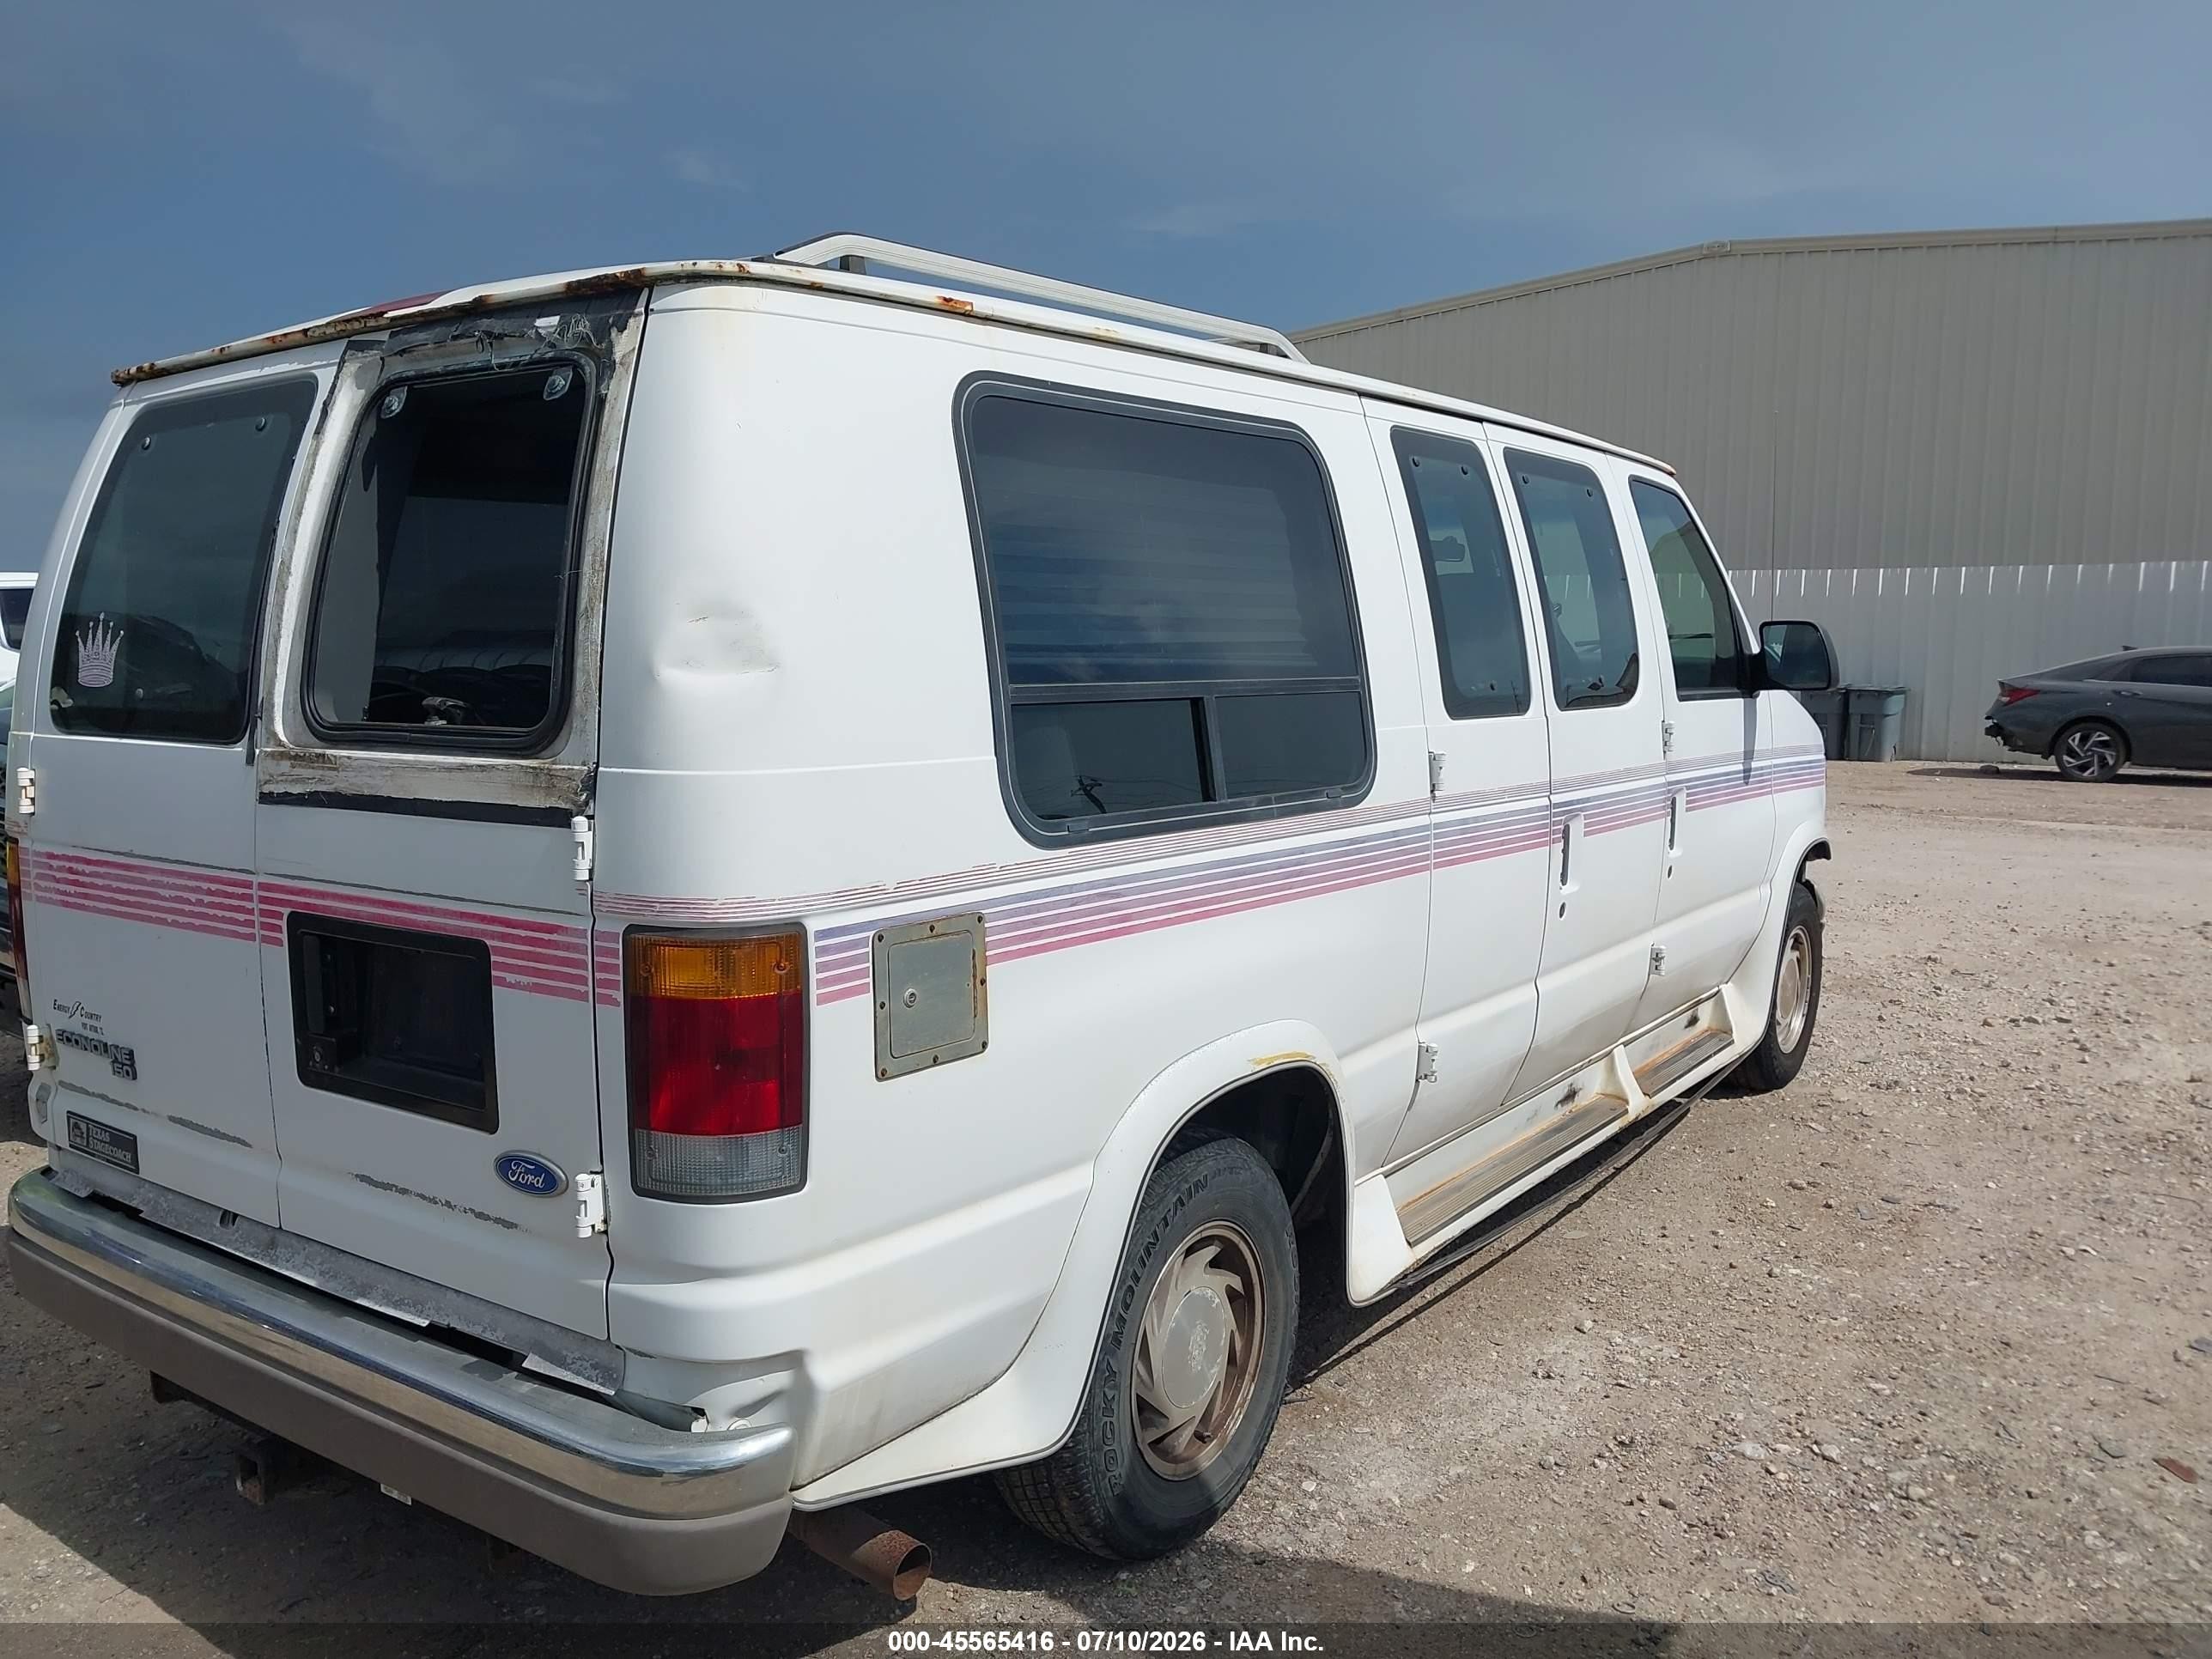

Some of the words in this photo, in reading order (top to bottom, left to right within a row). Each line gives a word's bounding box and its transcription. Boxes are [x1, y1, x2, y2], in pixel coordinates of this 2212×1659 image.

[55, 1029, 135, 1066] ECONOLINE
[110, 1060, 137, 1081] 150
[88, 1124, 111, 1142] TEXAS
[88, 1137, 131, 1164] STAGECOACH
[508, 1160, 545, 1188] Ford
[1111, 1173, 1208, 1350] MOUNTAIN
[1102, 1358, 1125, 1497] ROCKY
